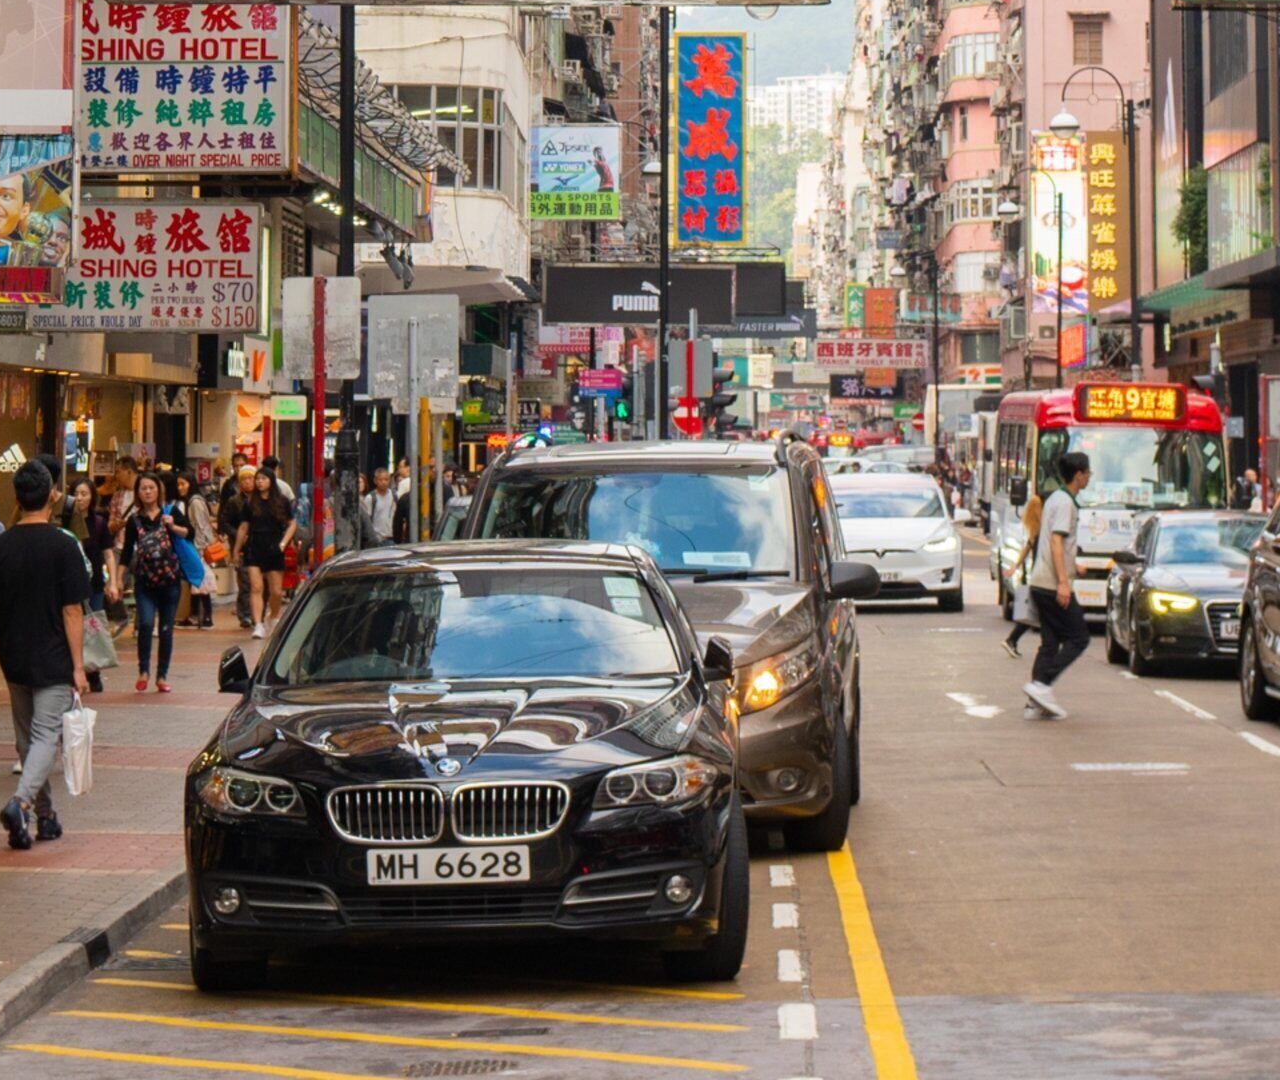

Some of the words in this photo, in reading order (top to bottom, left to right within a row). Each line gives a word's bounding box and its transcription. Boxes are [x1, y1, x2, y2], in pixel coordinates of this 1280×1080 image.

[179, 38, 279, 60] HOTEL
[83, 66, 141, 95] 設備
[155, 65, 278, 95] 時鐘特平
[132, 154, 161, 167] OVER
[166, 154, 195, 167] NIGHT
[200, 154, 244, 167] SPECIAL
[251, 153, 282, 167] PRICE
[567, 193, 612, 201] SPORTS
[1089, 142, 1118, 298] 興旺麻雀娛樂
[80, 259, 157, 278] SHING
[167, 259, 253, 278] HOTEL
[212, 281, 254, 303] $70
[612, 295, 660, 312] PUMA
[71, 315, 95, 328] PRICE
[128, 315, 143, 328] DAY
[211, 305, 255, 328] $150
[739, 323, 774, 332] FASTER
[374, 849, 419, 883] MH
[435, 847, 522, 880] 6628
